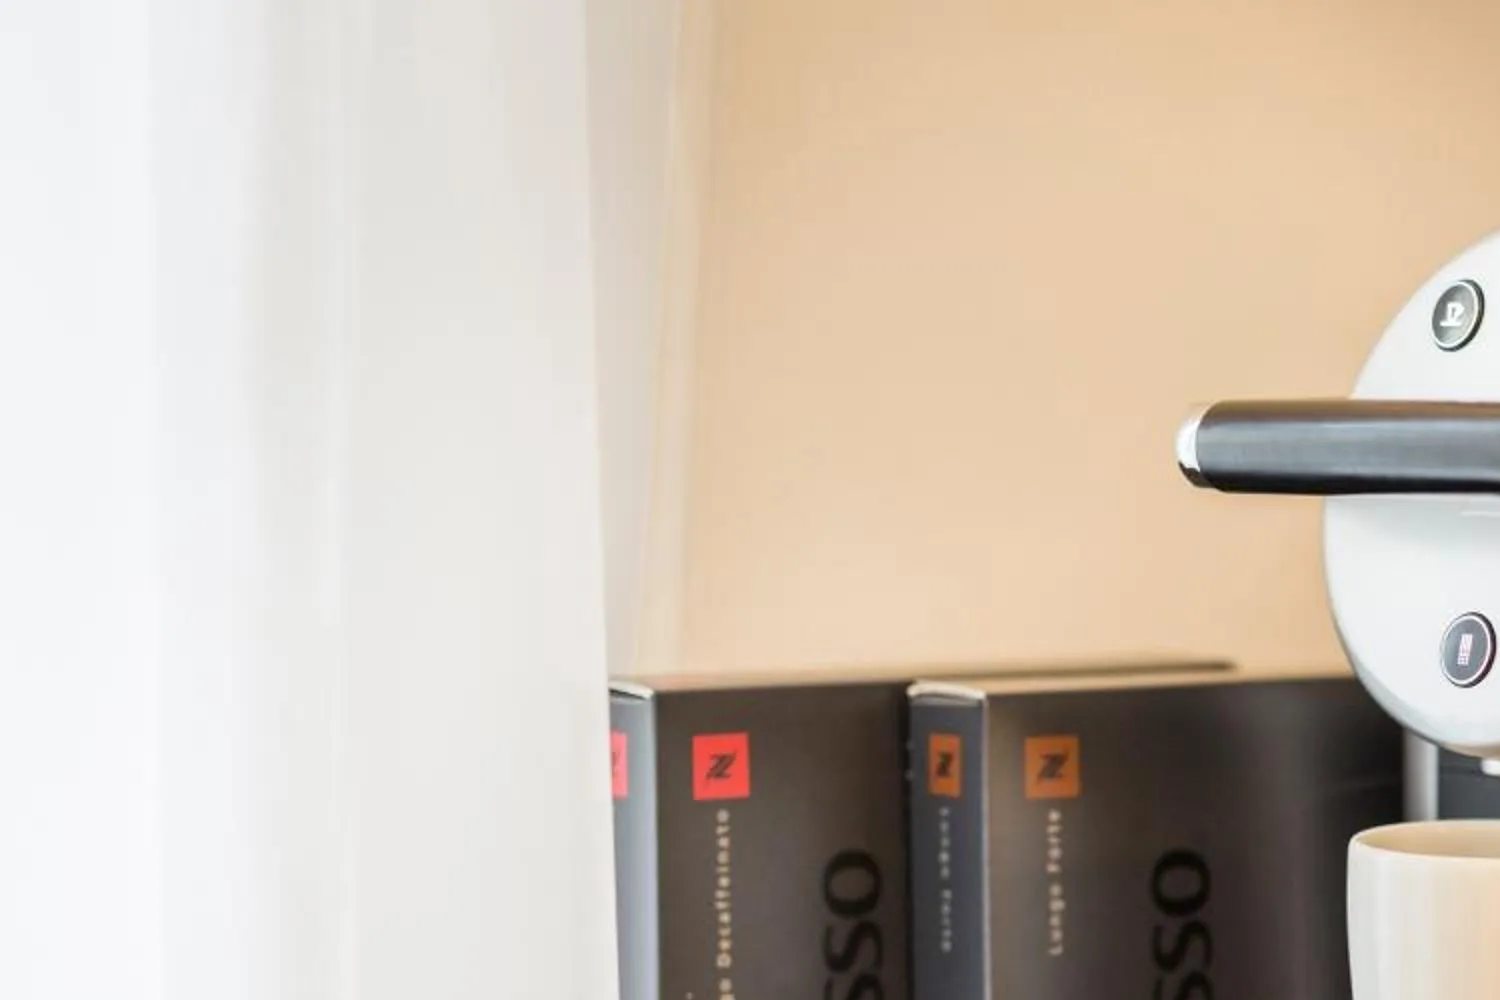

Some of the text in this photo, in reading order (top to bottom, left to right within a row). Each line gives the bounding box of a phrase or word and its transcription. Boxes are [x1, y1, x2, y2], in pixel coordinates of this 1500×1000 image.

[715, 809, 733, 968] Decaffeinato
[1046, 809, 1065, 956] Lungo Forte
